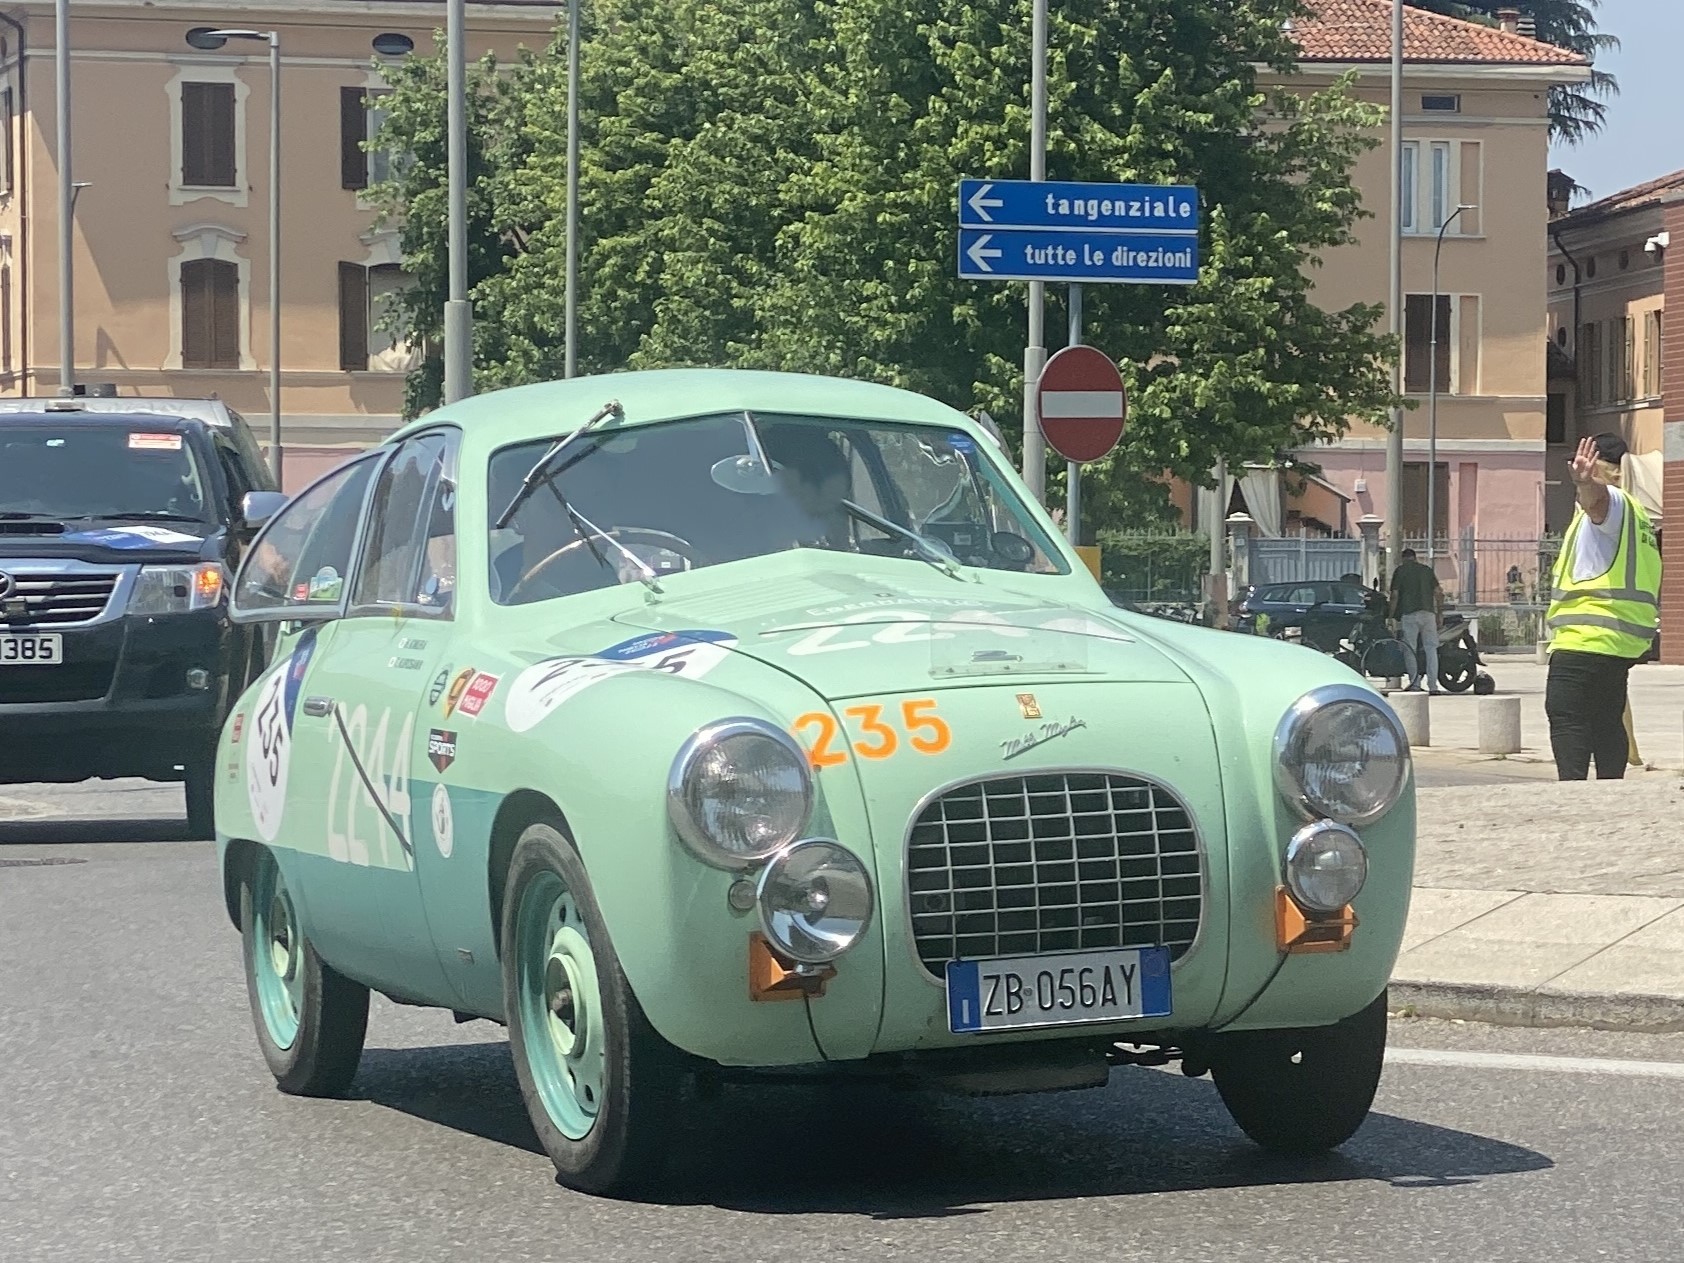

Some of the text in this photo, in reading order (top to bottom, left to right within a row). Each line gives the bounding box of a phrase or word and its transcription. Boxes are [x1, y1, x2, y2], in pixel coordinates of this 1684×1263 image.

[1046, 193, 1191, 220] tangenziale
[1025, 244, 1192, 269] tutte le direzioni
[0, 638, 54, 660] 385
[790, 698, 952, 768] 235
[983, 972, 1024, 1016] ZB
[1036, 964, 1137, 1011] 056AY
